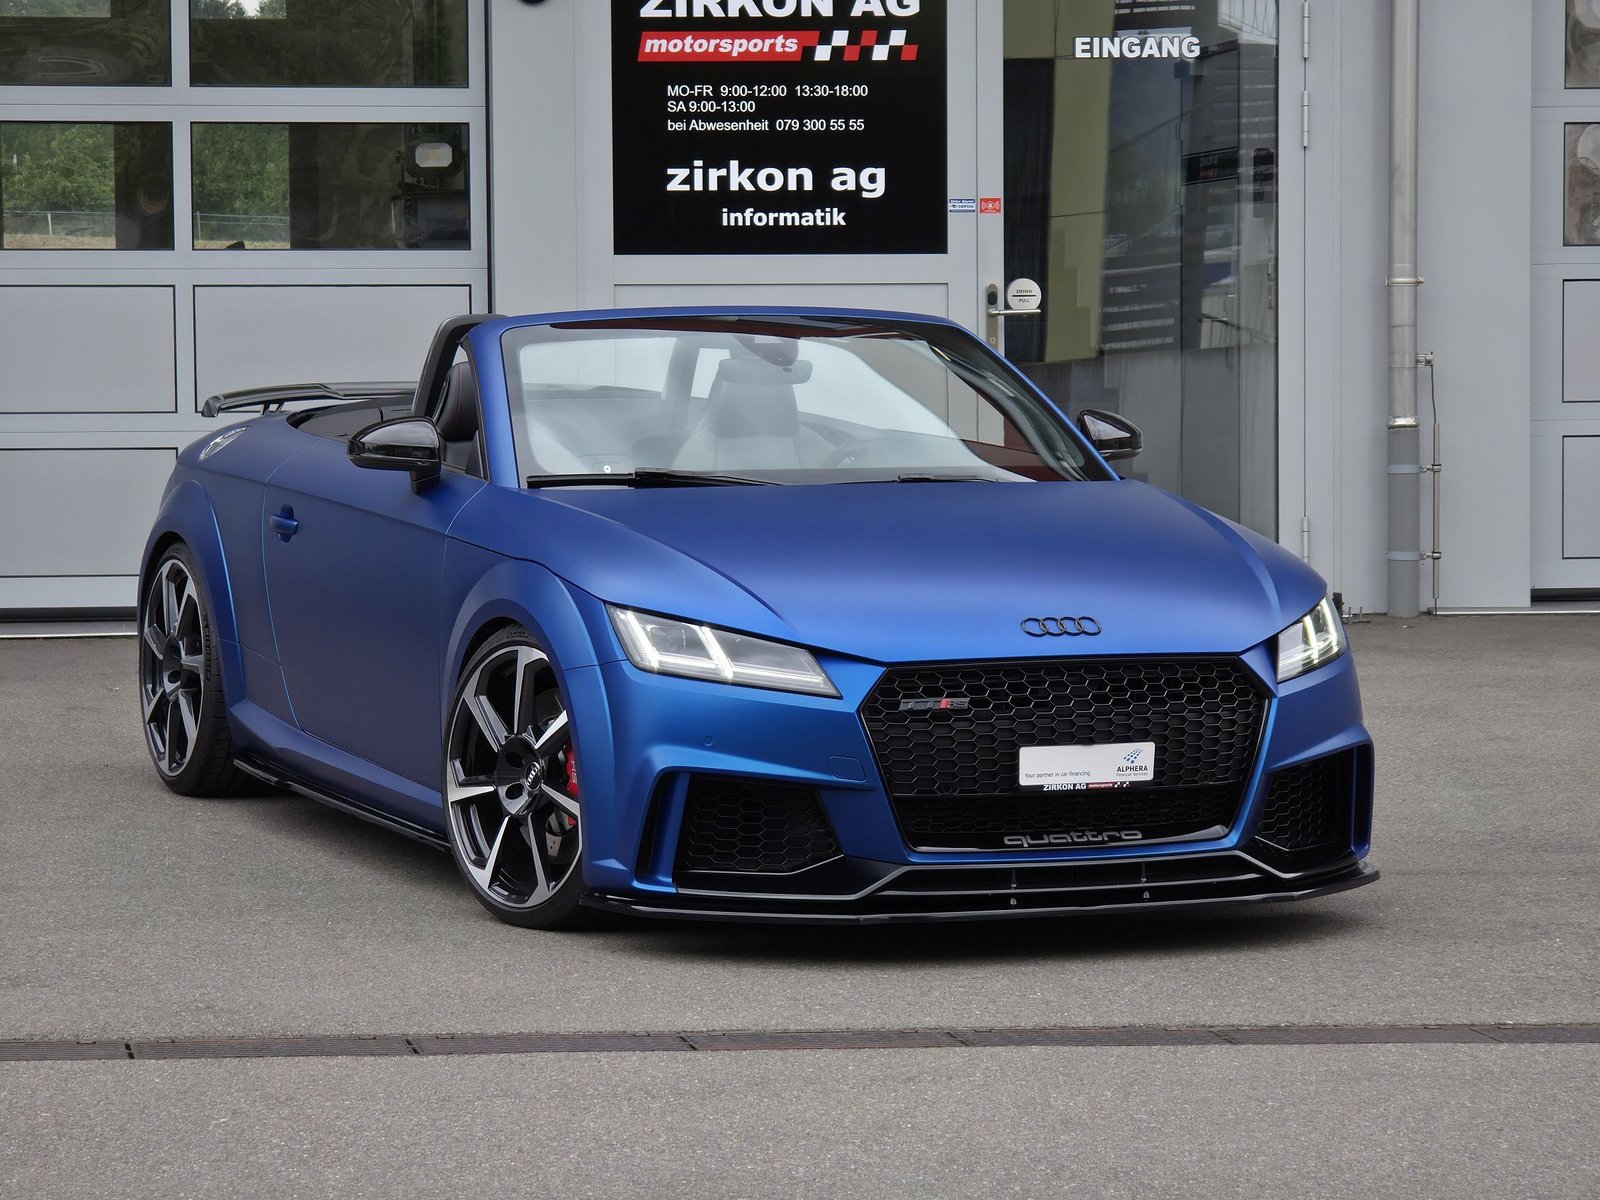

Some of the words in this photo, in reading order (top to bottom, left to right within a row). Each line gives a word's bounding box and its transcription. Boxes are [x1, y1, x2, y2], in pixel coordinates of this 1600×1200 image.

[640, 0, 834, 18] ZIRKON
[849, 0, 920, 17] AG
[644, 34, 799, 57] motorsports
[1074, 36, 1201, 59] EINGANG
[667, 85, 713, 97] MO-FR
[720, 85, 787, 97] 9:00-12:00
[795, 85, 869, 97] 13:30-18:00
[667, 101, 686, 113] SA
[689, 101, 756, 113] 9:00-13:00
[667, 119, 686, 131] bei
[689, 119, 769, 131] Abwesenheit
[776, 119, 799, 131] 079
[803, 119, 826, 131] 300
[830, 119, 845, 131] 55
[849, 119, 865, 131] 55
[666, 160, 813, 192] zirkon
[831, 167, 886, 199] ag
[722, 208, 847, 227] informatik
[1116, 765, 1148, 773] ALPHERA
[1043, 783, 1073, 791] ZIRKON
[1003, 829, 1142, 848] quattro
